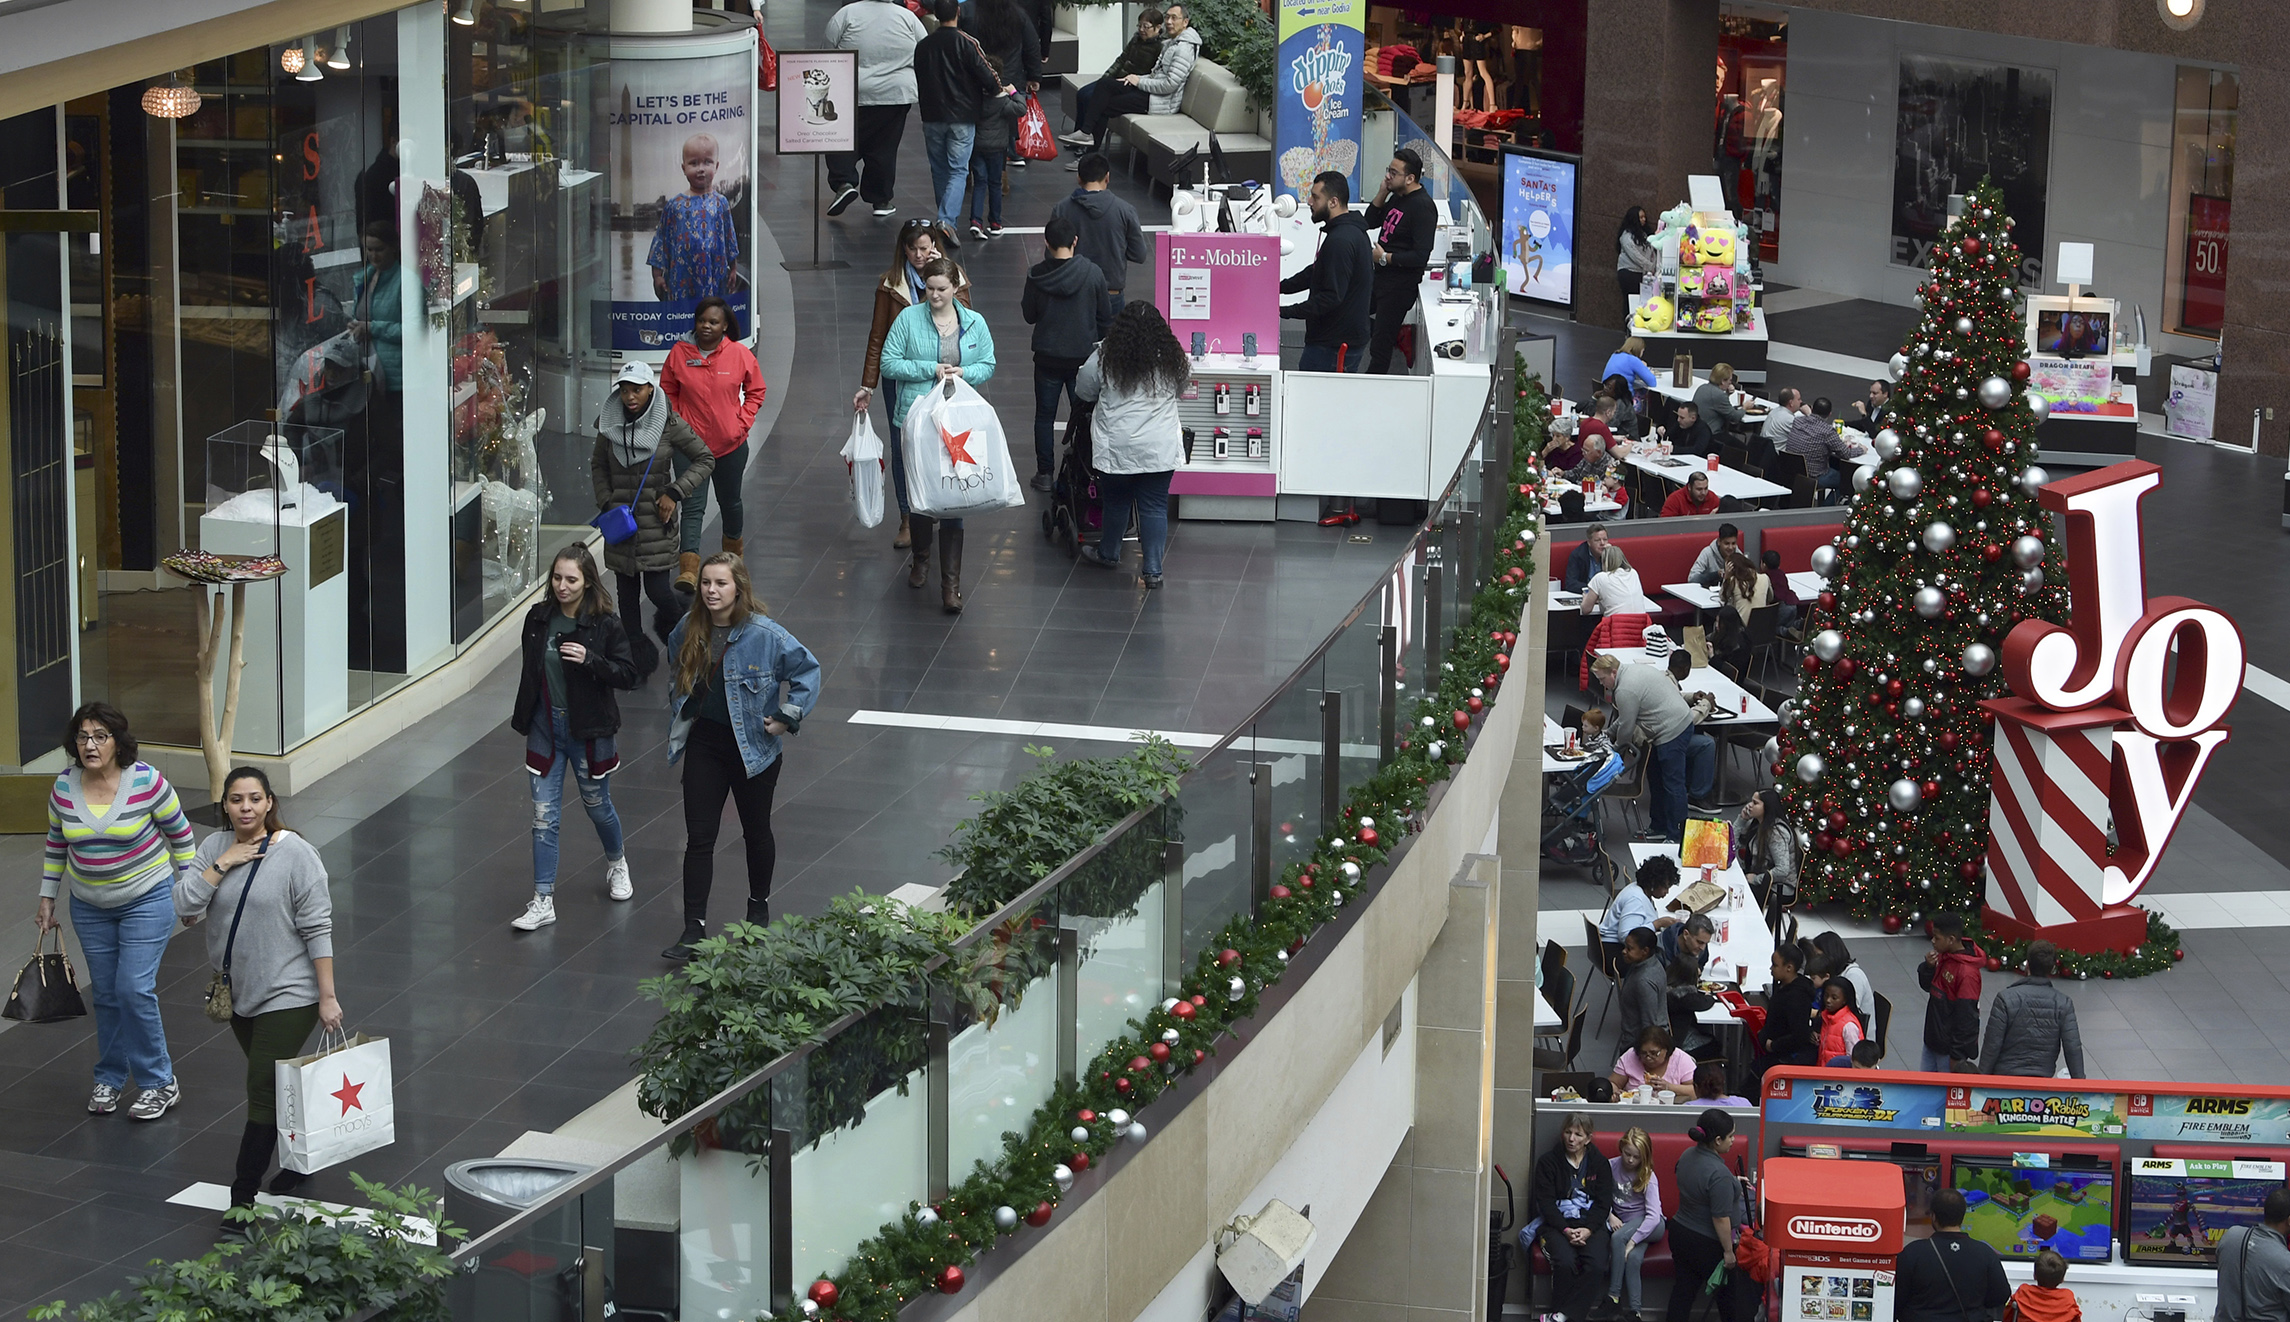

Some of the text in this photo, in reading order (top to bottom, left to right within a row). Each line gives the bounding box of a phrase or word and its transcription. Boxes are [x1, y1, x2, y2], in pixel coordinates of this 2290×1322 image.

[1317, 6, 1330, 16] near
[1322, 77, 1346, 96] dots
[683, 94, 701, 107] BE
[704, 91, 728, 105] THE
[1330, 98, 1342, 109] Ice
[609, 105, 745, 125] CAPITAL OF CARING.
[1323, 108, 1349, 120] Cream
[1520, 177, 1557, 193] SANTA'S
[1518, 188, 1557, 208] HELPERS
[2195, 240, 2219, 274] 50
[629, 312, 663, 321] TODAY
[2039, 362, 2095, 371] DRAGON BREATH
[941, 466, 994, 492] macy's
[1982, 1097, 2045, 1115] MARIO
[2186, 1099, 2253, 1115] ARMS
[1816, 1112, 1876, 1121] TOURNAMENT
[1872, 1109, 1900, 1122] DX
[1998, 1113, 2076, 1127] KINGDOM BATTLE
[333, 1114, 372, 1138] macy's
[2177, 1122, 2206, 1136] FIRE
[2206, 1123, 2251, 1132] EMBLEM
[2142, 1160, 2173, 1169] ARMS
[2189, 1162, 2203, 1170] Ask
[2212, 1163, 2228, 1171] Play
[1795, 1220, 1875, 1237] Nintendo
[1811, 1255, 1831, 1263] 3DS
